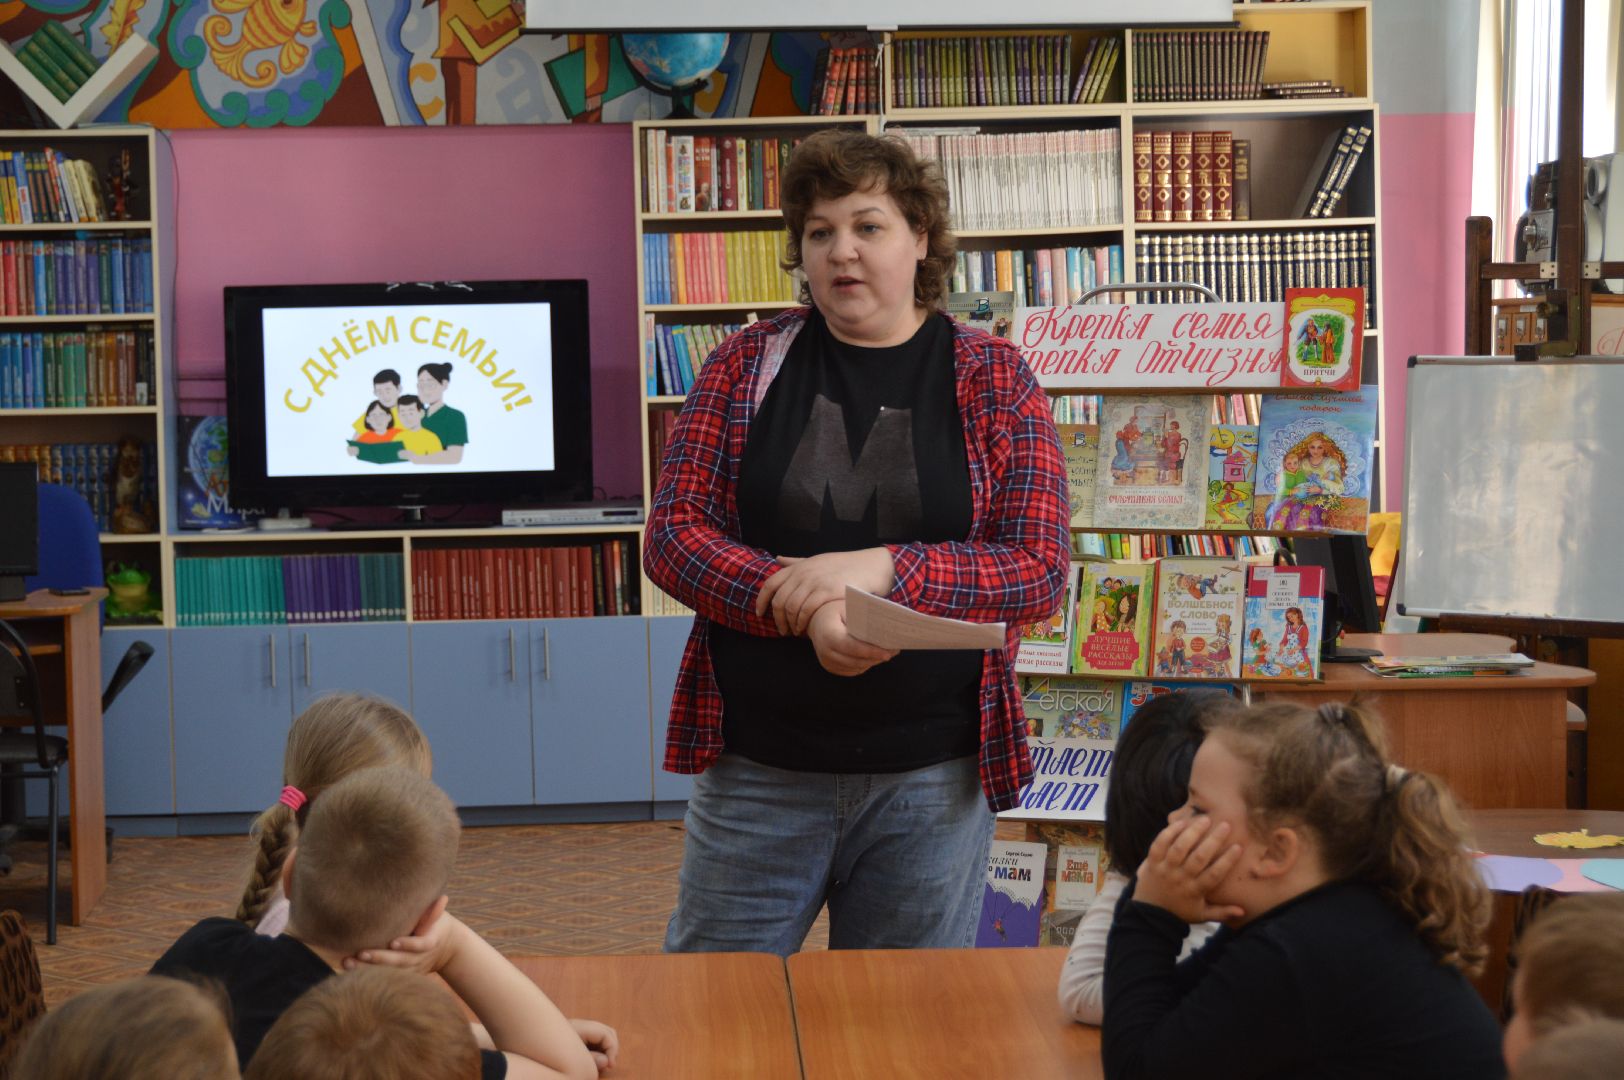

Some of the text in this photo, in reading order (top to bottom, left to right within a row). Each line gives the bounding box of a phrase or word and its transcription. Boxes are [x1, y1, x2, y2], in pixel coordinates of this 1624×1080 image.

[1022, 305, 1283, 348] Крепка семья
[284, 315, 533, 413] С ДНЁМ СЕМЬИ!
[1020, 340, 1282, 387] репка Отчизна
[1303, 368, 1336, 376] ПРИТЧИ
[1168, 600, 1234, 609] ВОЛШЕБНОЕ
[1180, 610, 1217, 619] СЛОВО
[1094, 635, 1132, 644] ЛУЧШИЕ
[1088, 652, 1133, 660] РАССКАЗЫ
